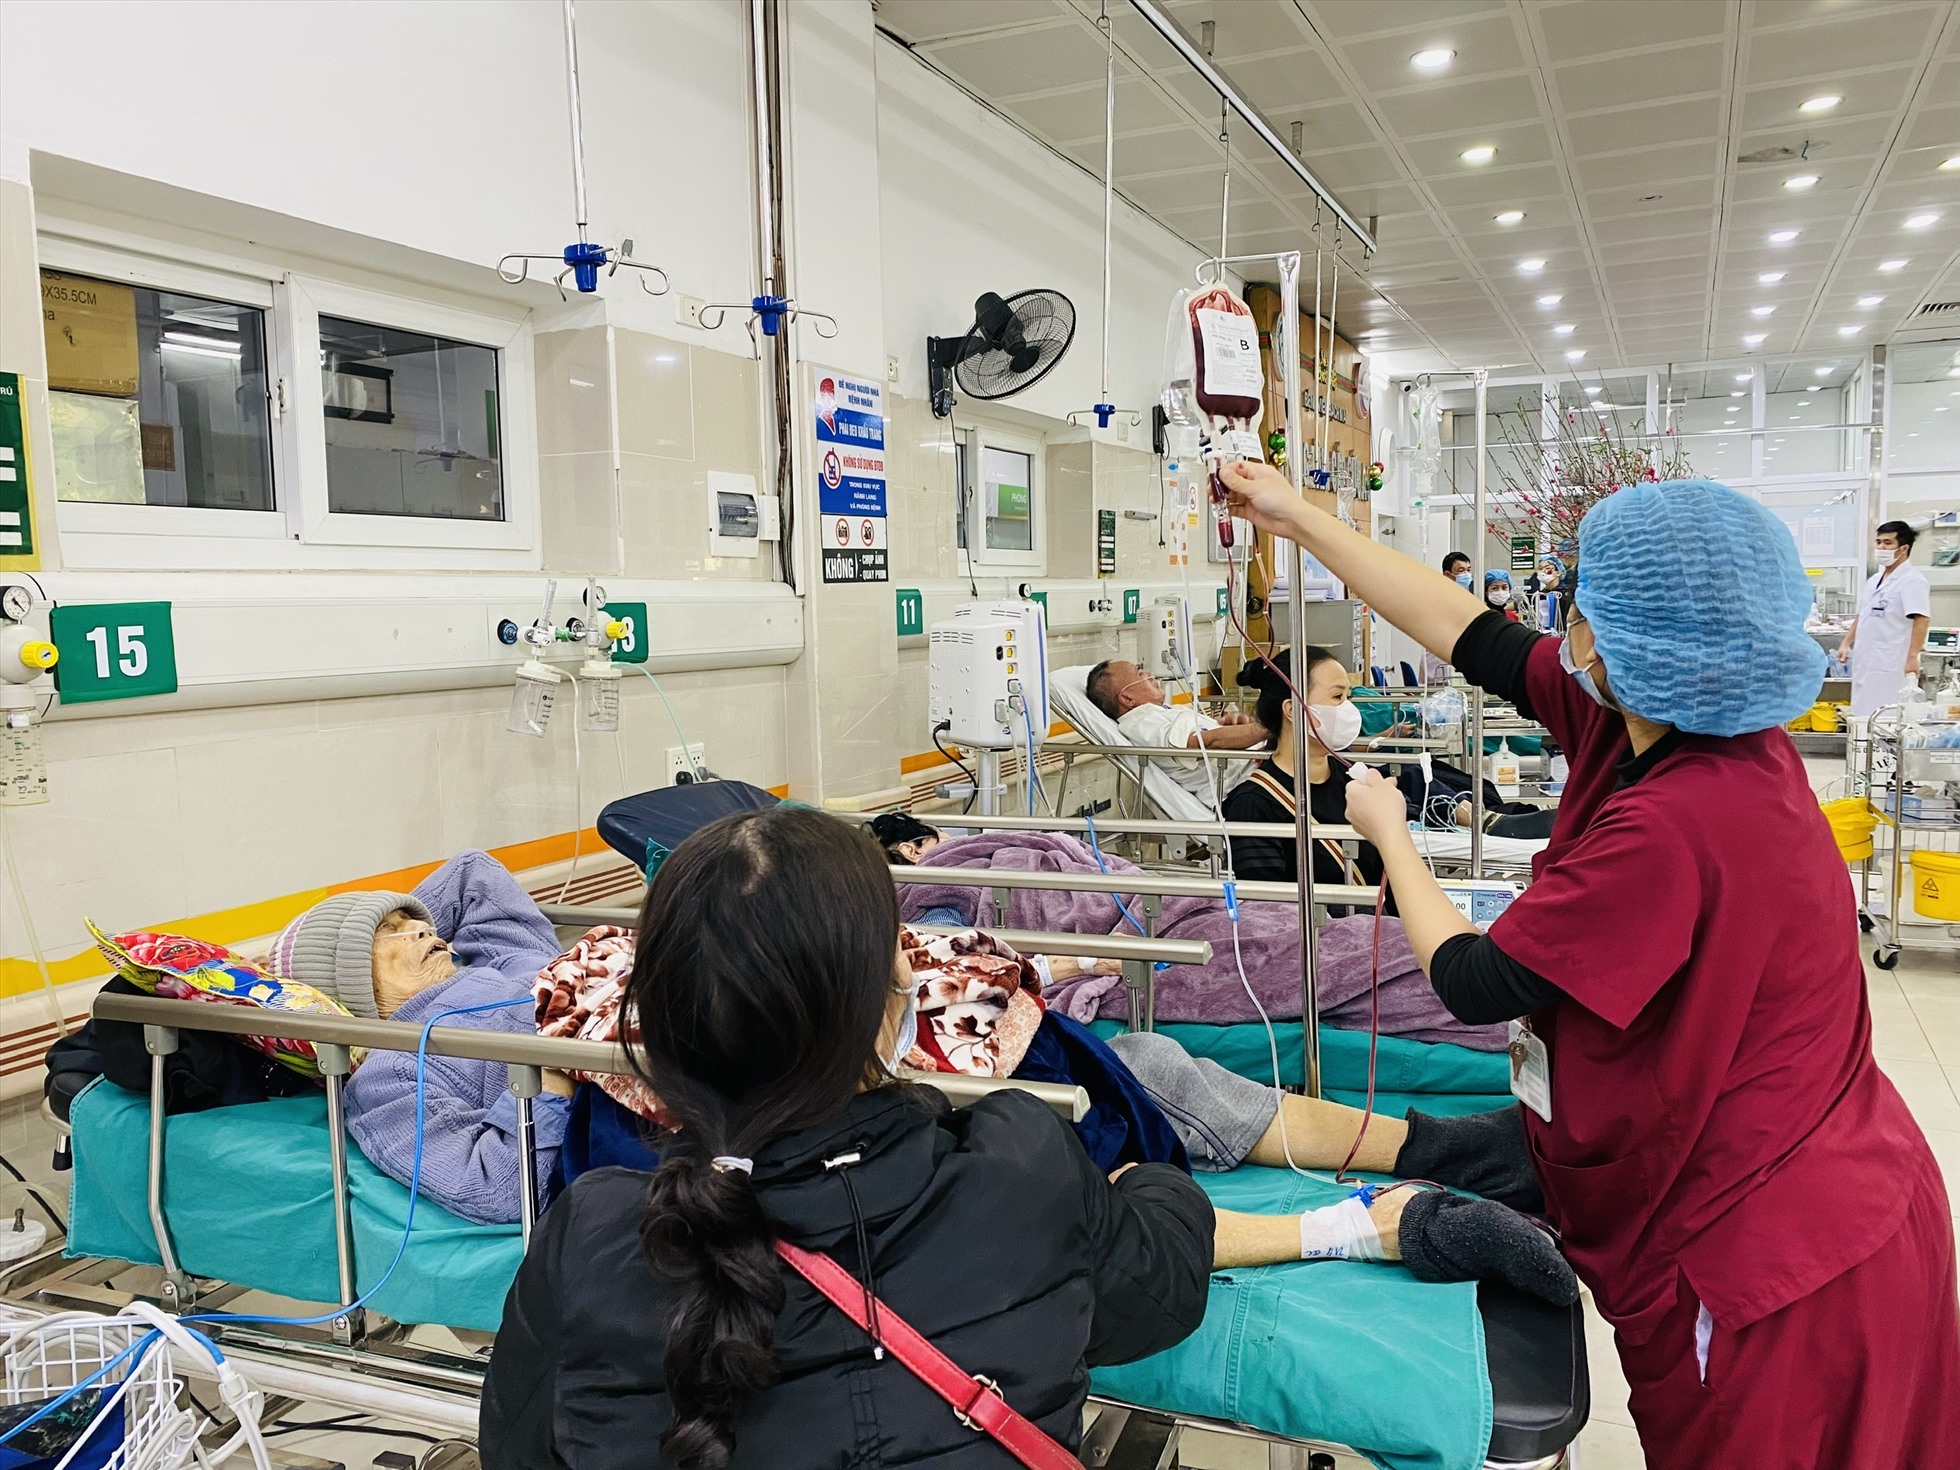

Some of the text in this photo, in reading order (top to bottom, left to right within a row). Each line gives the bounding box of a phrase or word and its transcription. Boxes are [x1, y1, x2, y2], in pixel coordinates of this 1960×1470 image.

[1240, 339, 1250, 350] B
[825, 553, 854, 579] KHÔNG
[901, 598, 916, 625] 11
[1128, 596, 1137, 615] 07
[86, 625, 148, 678] 15
